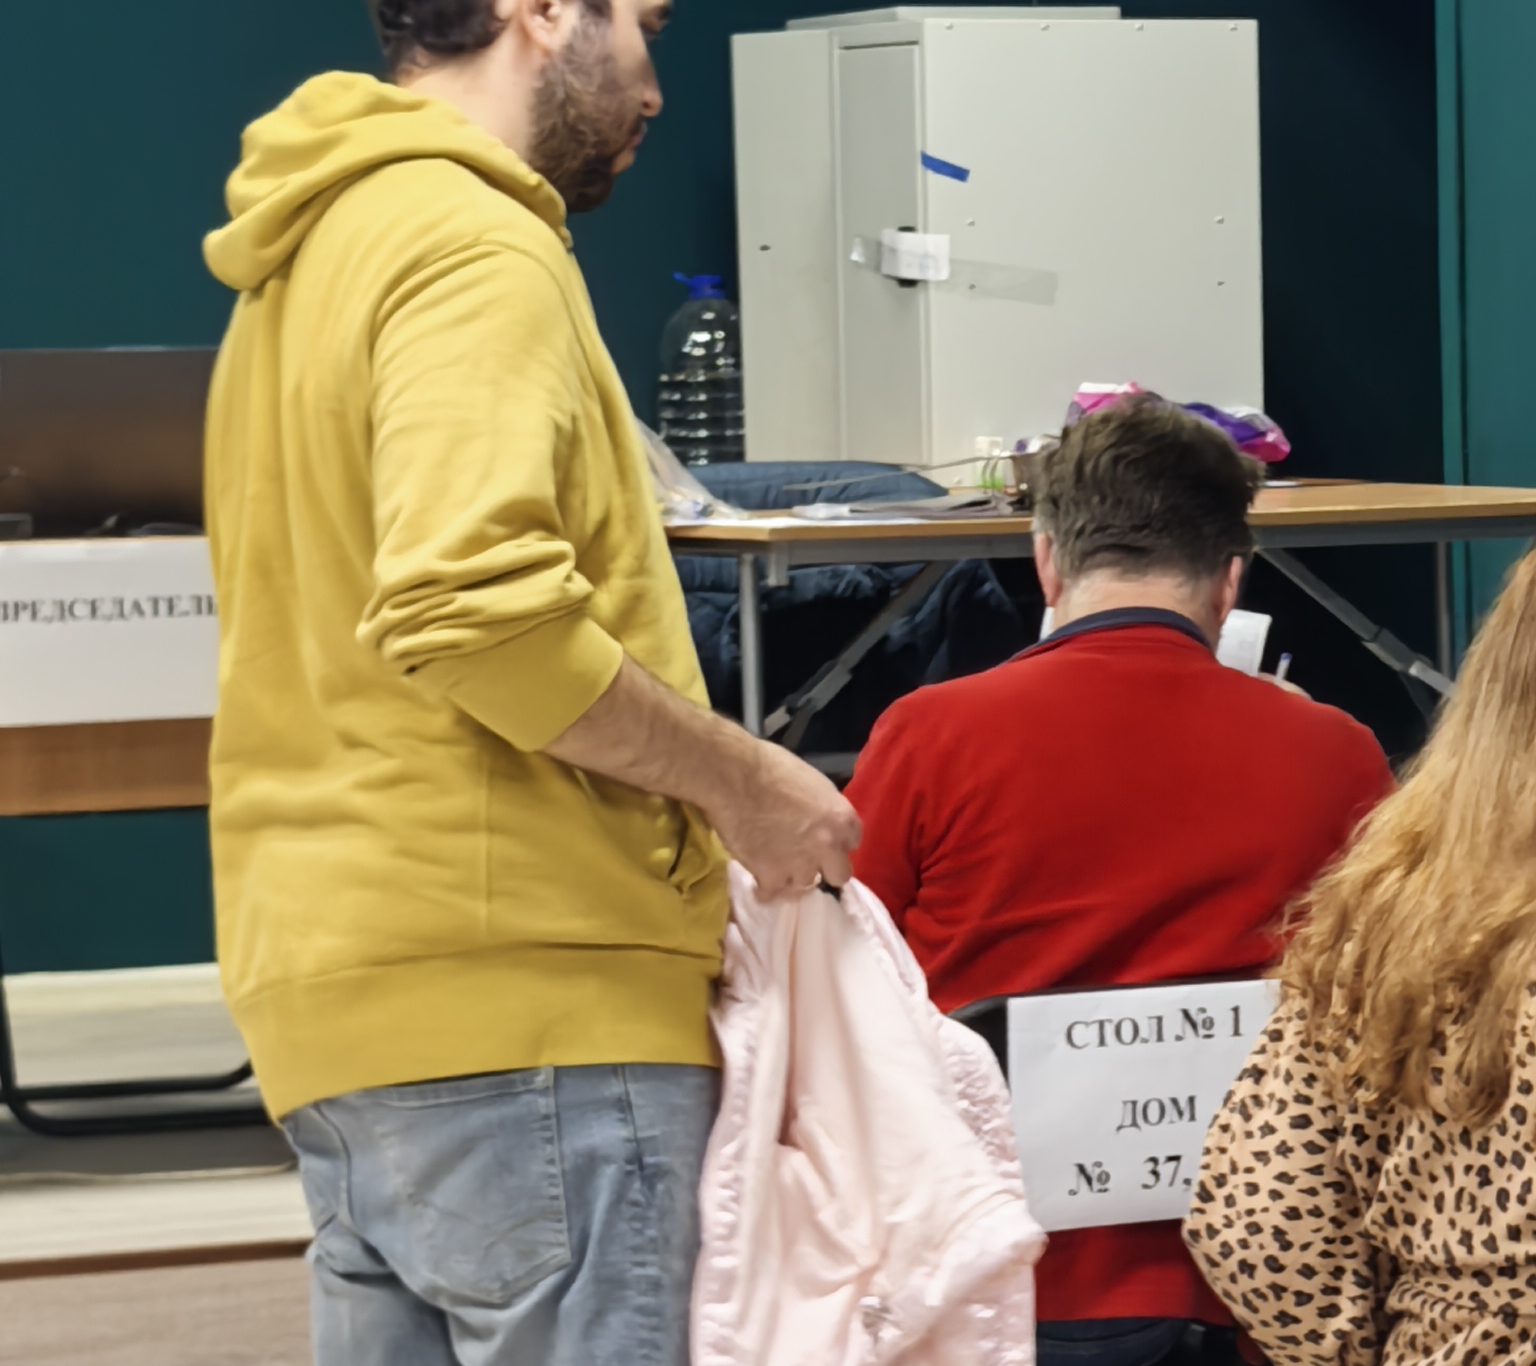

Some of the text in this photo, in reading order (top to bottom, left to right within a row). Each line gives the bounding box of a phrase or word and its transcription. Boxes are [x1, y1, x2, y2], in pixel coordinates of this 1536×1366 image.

[1065, 1004, 1244, 1050] СТОЛ № 1
[1115, 1094, 1198, 1133] ДОМ
[1068, 1160, 1111, 1196] №
